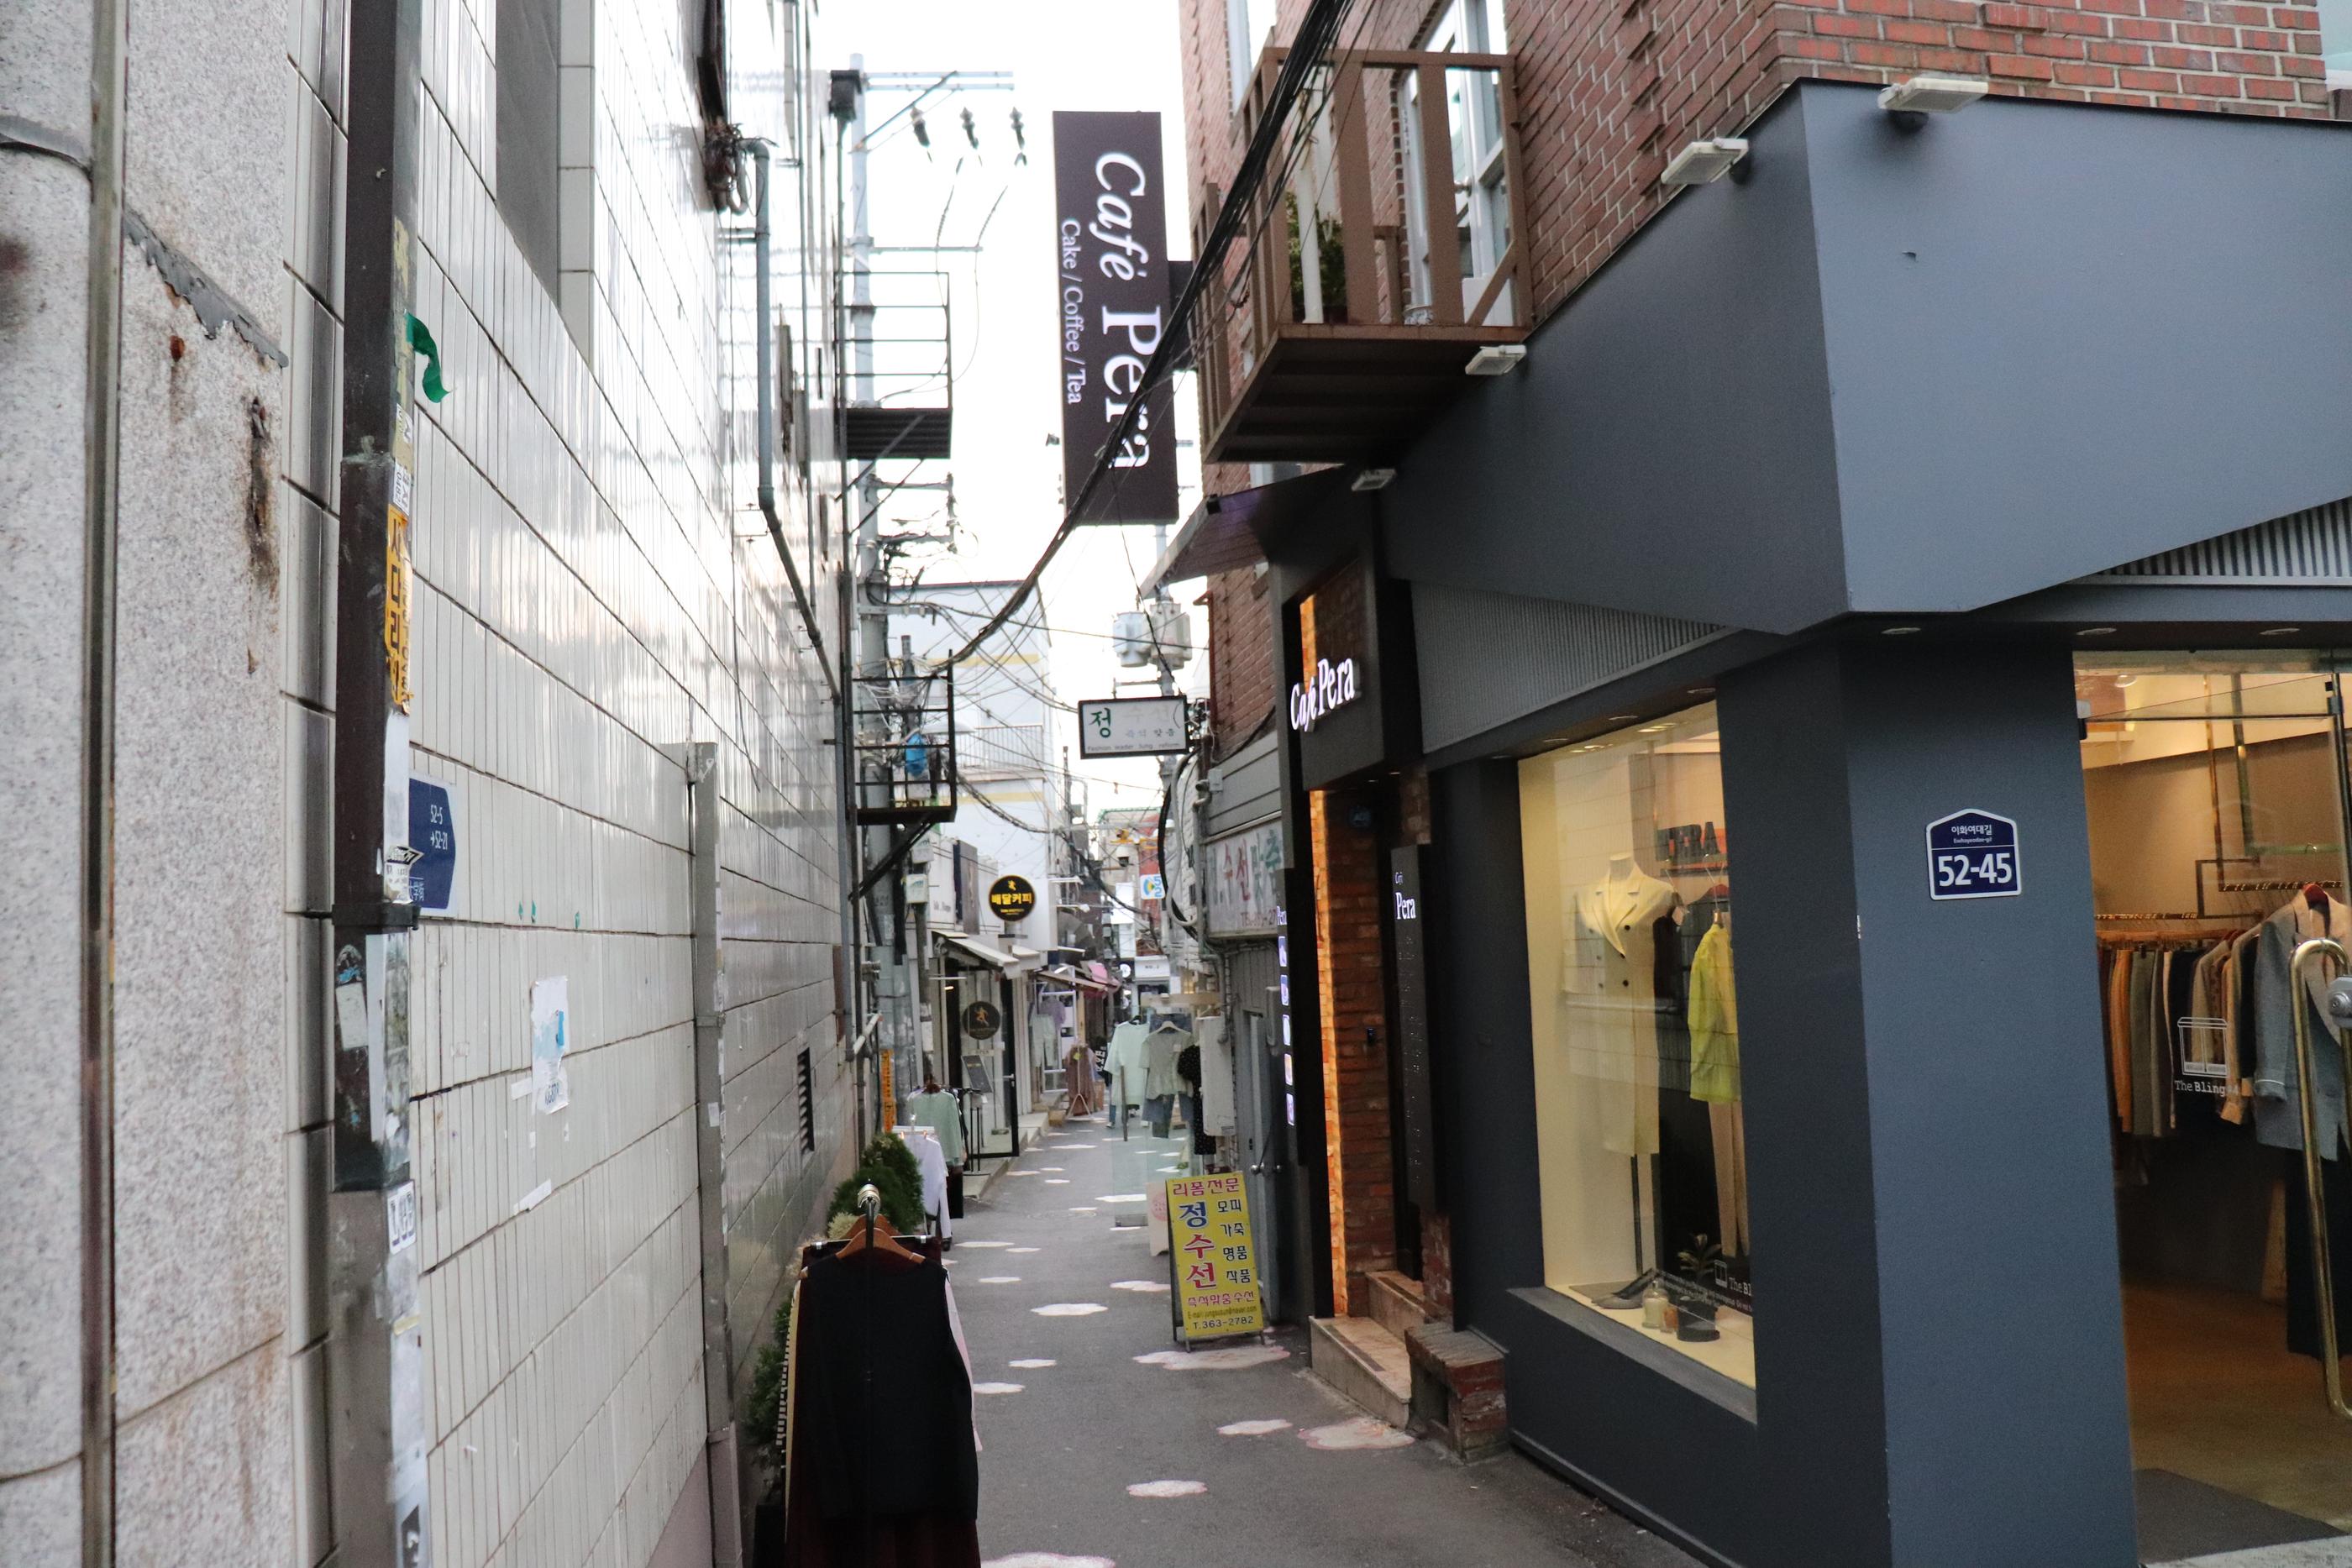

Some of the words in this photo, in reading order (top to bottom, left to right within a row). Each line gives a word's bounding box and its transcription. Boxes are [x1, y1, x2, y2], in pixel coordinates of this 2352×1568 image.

[1089, 152, 1149, 282] Café
[1060, 218, 1082, 270] Cake
[1063, 284, 1085, 352] Coffee
[1067, 367, 1086, 405] Tea
[1317, 658, 1356, 716] Pera
[430, 805, 443, 825] 52-5
[1950, 824, 1992, 836] 이화여대길
[1937, 852, 2013, 887] 52-45
[1394, 892, 1417, 920] Pera
[2174, 1079, 2193, 1092] The
[1173, 1177, 1240, 1198] 리폼전문
[1217, 1198, 1242, 1213] 모피
[1220, 1222, 1245, 1238] 가죽
[1223, 1245, 1248, 1261] 명품
